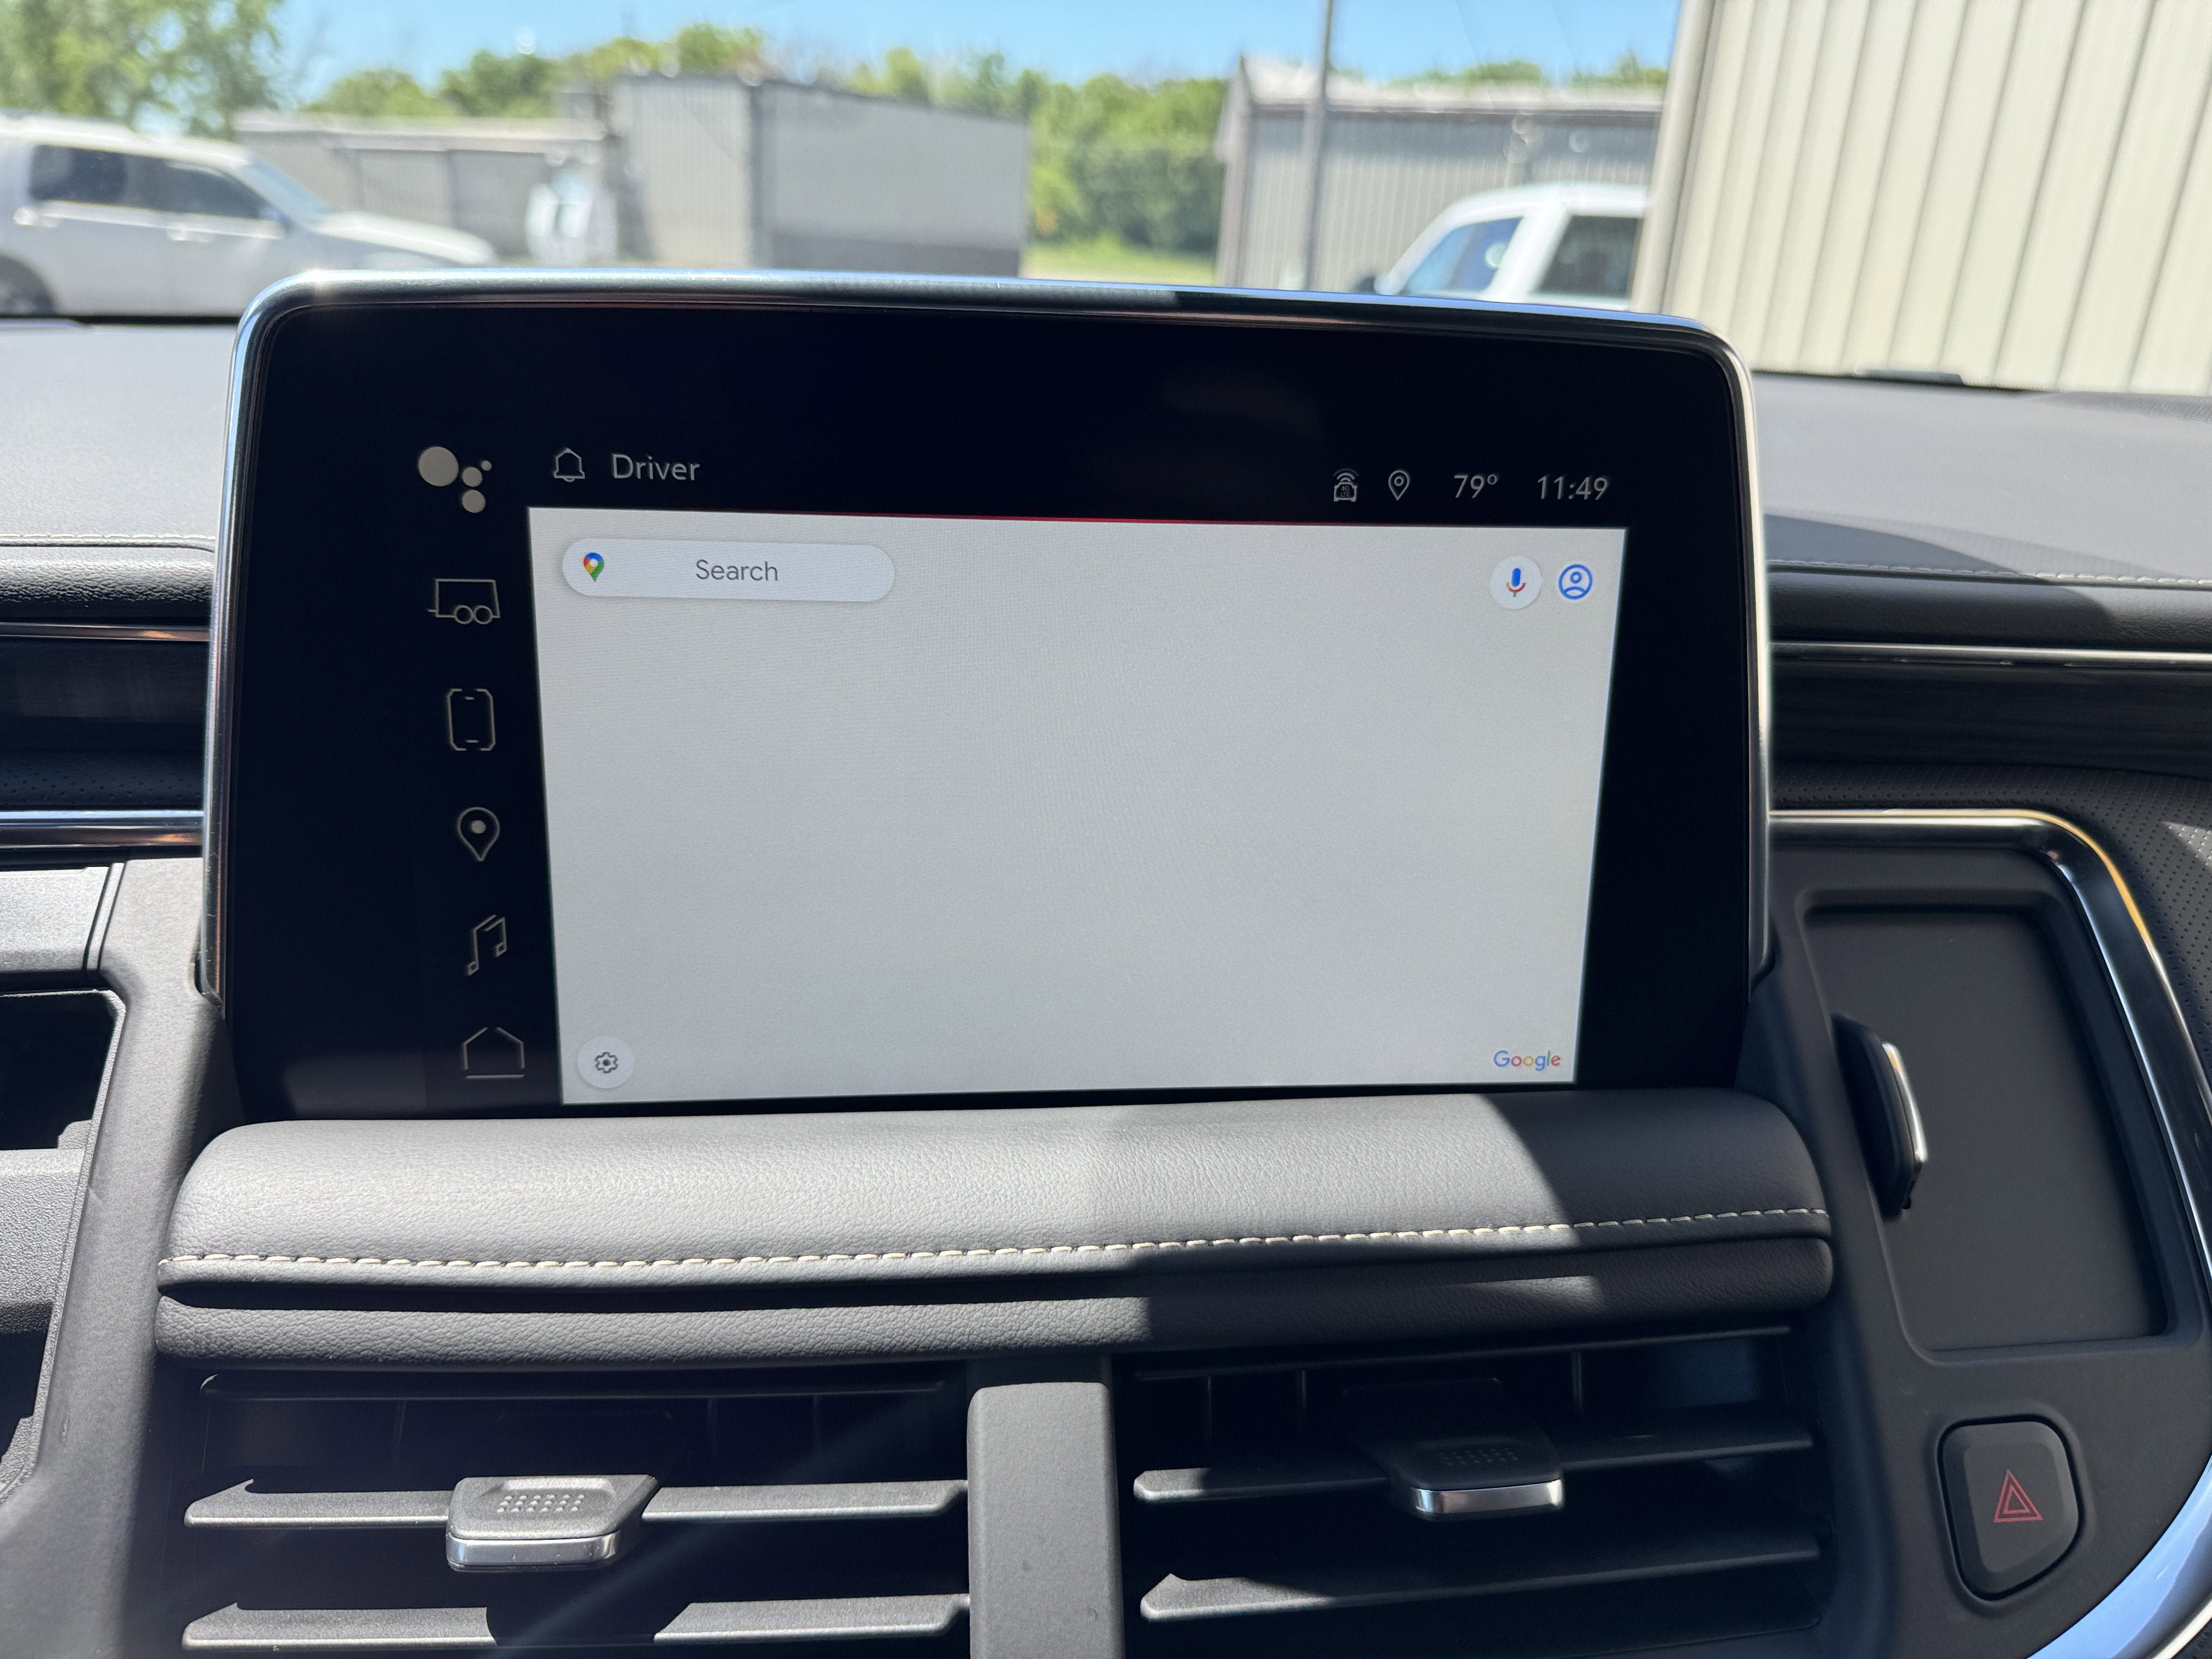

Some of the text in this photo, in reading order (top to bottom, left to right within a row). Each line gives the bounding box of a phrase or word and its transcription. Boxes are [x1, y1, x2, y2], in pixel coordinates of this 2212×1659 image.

[612, 454, 701, 481] Driver
[1537, 476, 1608, 500] 11:49
[696, 559, 778, 582] Search
[1493, 1049, 1561, 1071] Google
